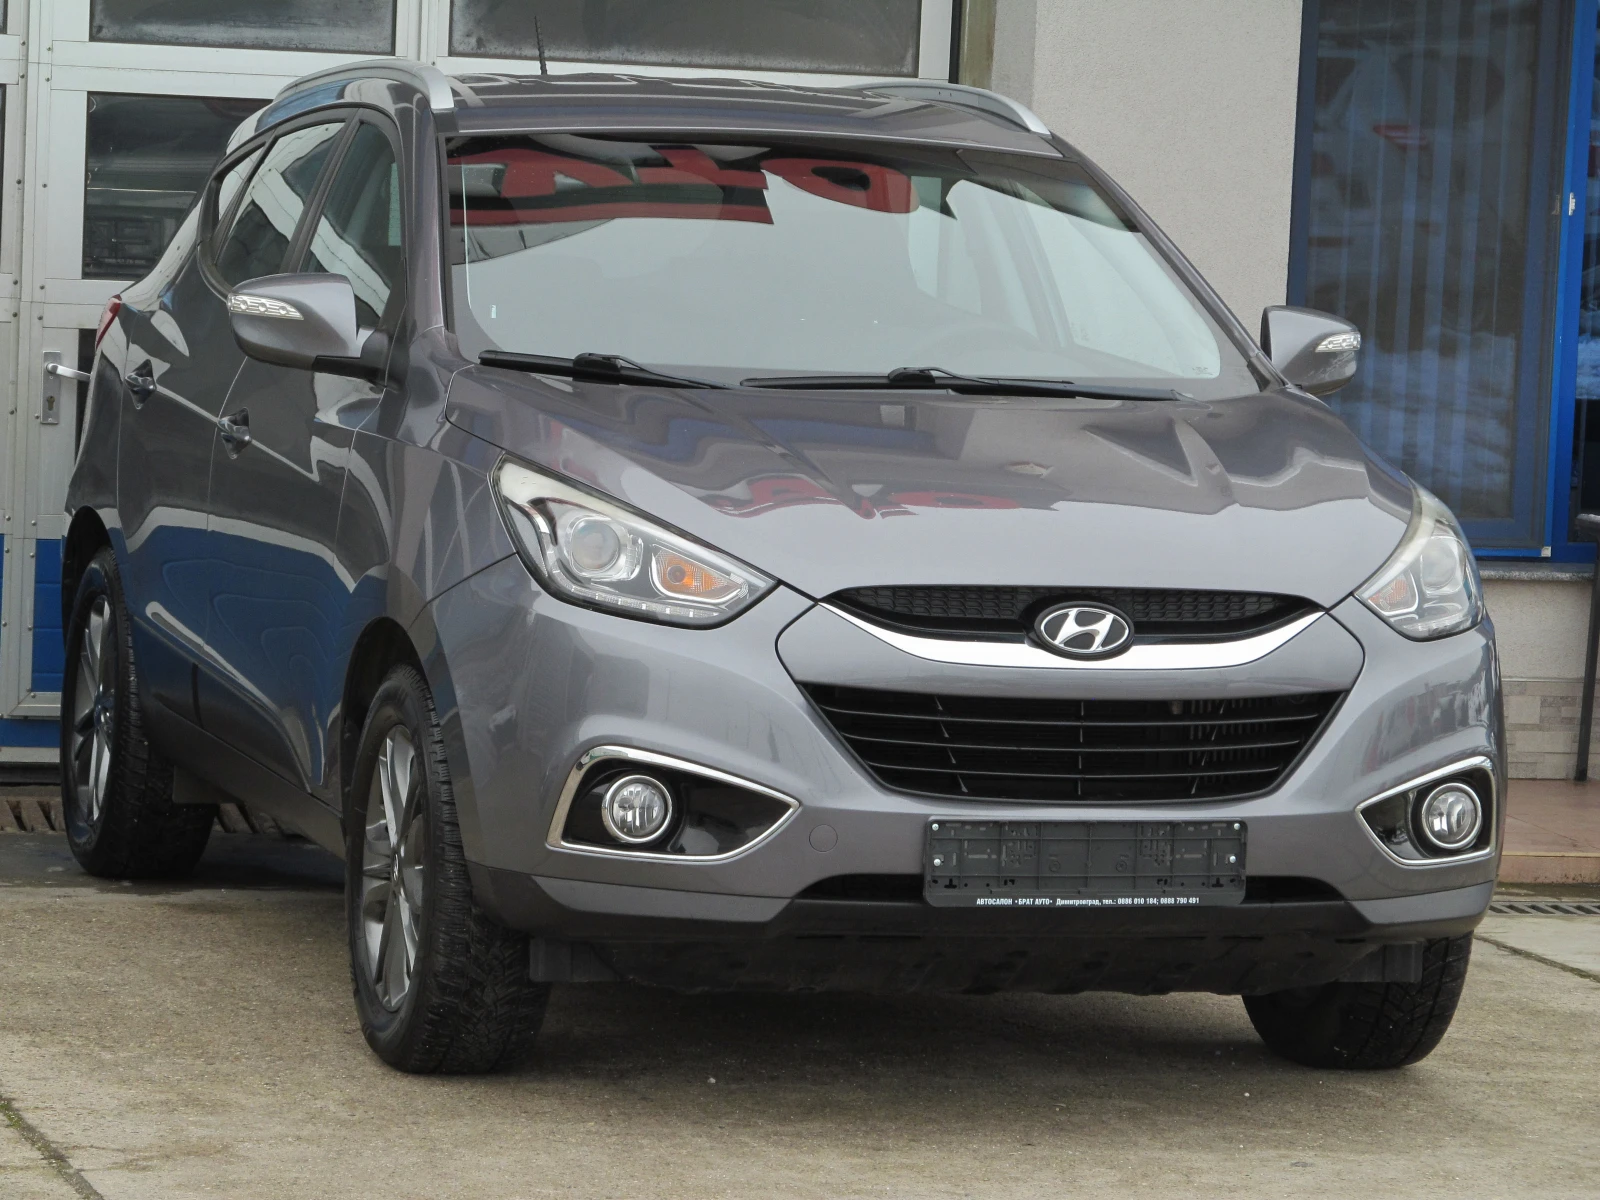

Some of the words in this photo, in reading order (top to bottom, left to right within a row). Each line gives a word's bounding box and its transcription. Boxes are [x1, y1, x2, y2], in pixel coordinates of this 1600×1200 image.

[976, 897, 1013, 906] АВТОСАЛОН
[1133, 897, 1145, 905] 010
[1176, 897, 1188, 905] 790
[1188, 896, 1200, 905] 491
